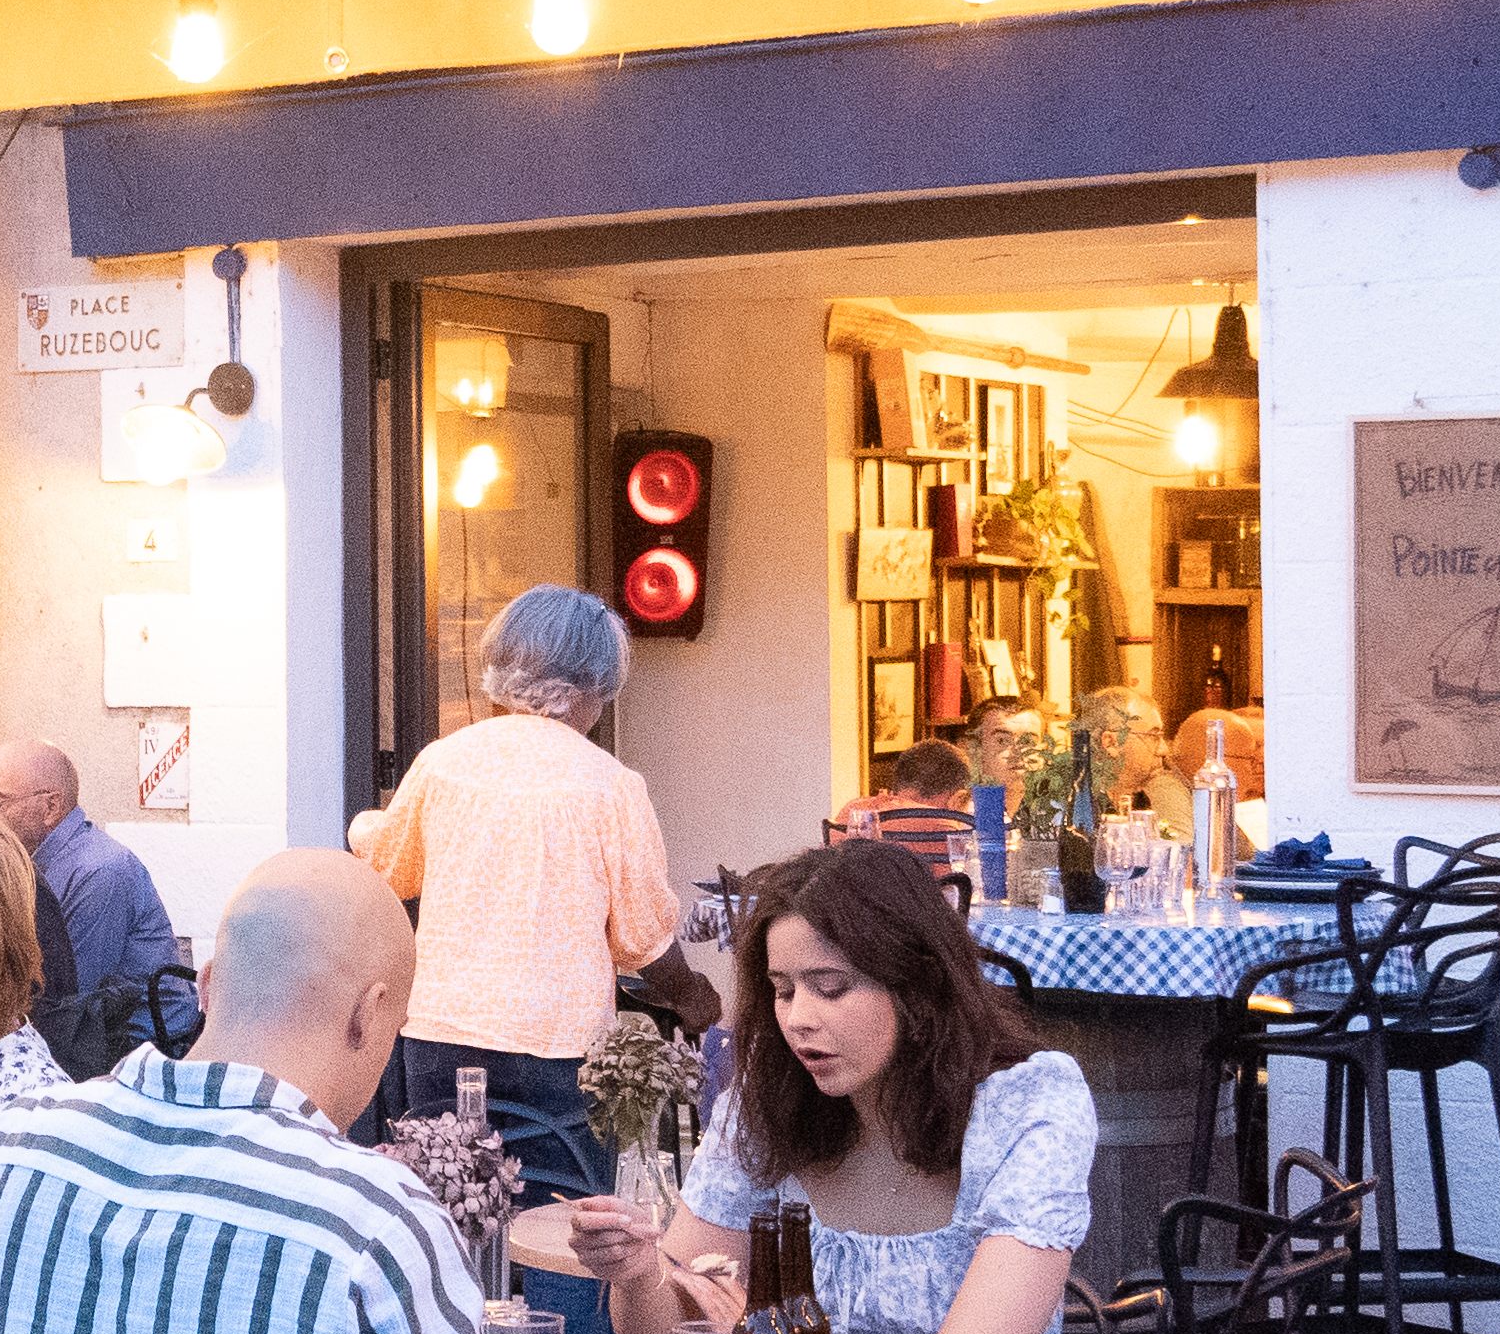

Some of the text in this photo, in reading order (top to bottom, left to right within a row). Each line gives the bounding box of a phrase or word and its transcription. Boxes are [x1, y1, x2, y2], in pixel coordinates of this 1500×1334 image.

[70, 296, 129, 316] PLACE
[144, 529, 156, 552] 4
[144, 739, 159, 755] IV
